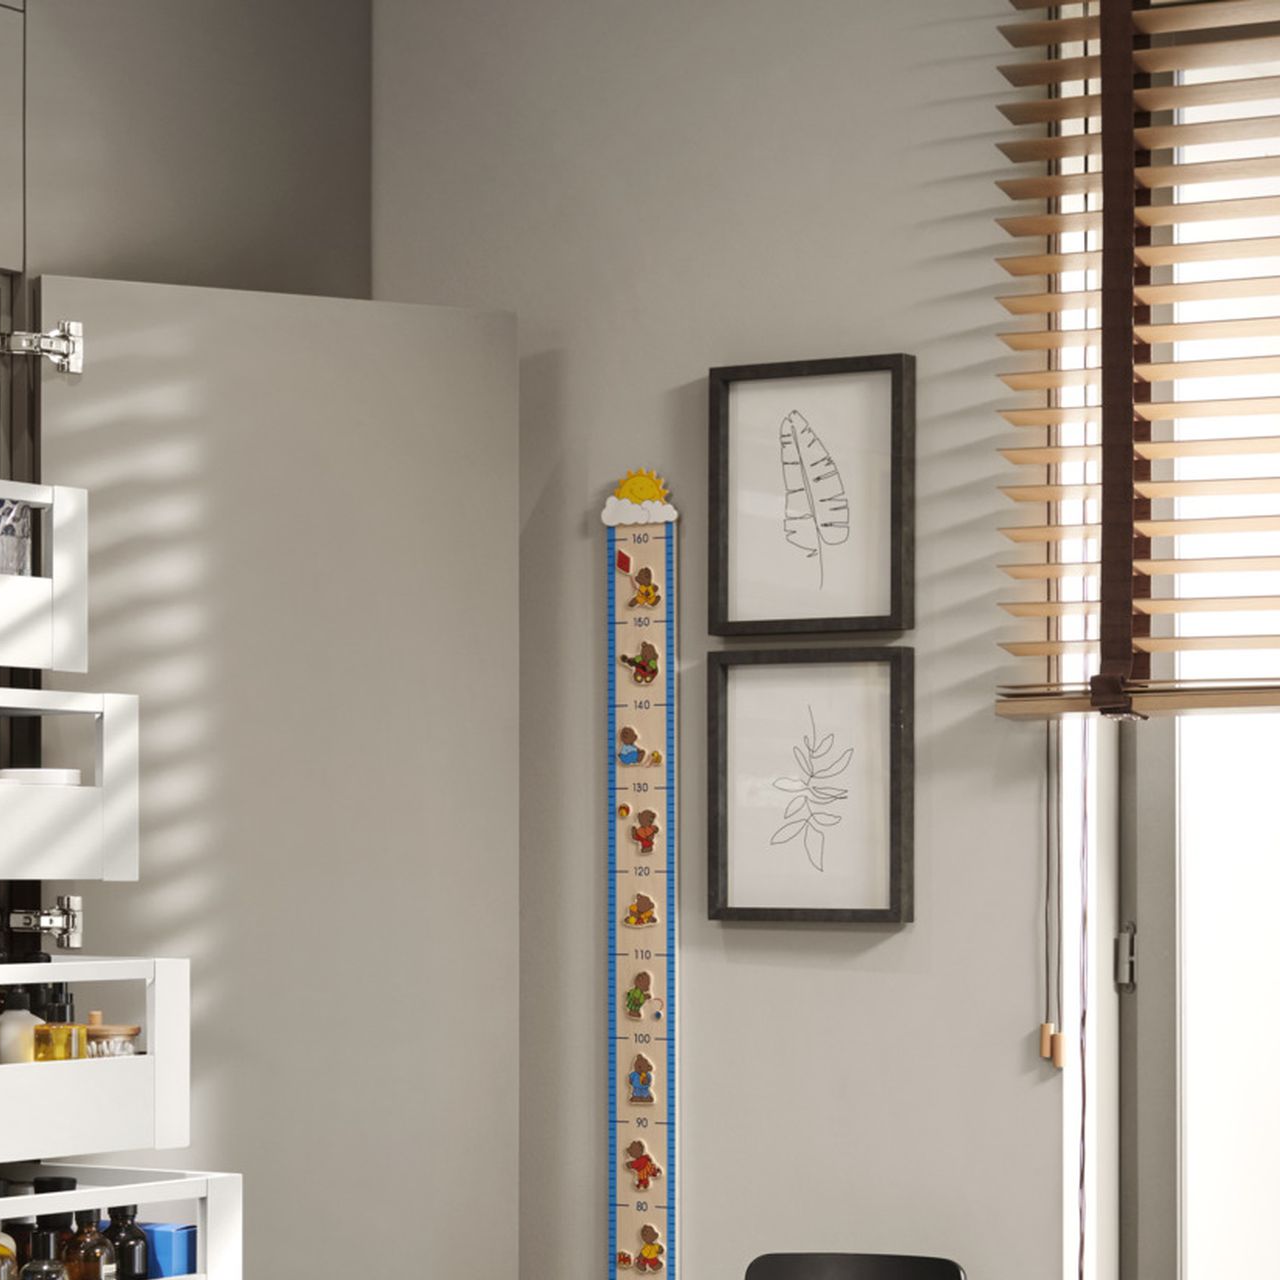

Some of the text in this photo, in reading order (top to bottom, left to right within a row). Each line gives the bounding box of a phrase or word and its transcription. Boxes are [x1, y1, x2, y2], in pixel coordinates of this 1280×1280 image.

[632, 532, 649, 545] 160
[633, 616, 650, 628] 150
[633, 699, 651, 710] 140
[632, 782, 649, 793] 130
[633, 866, 650, 877] 120
[634, 949, 652, 961] 110
[634, 1032, 651, 1044] 100
[635, 1116, 649, 1129] 90
[635, 1200, 649, 1212] 80
